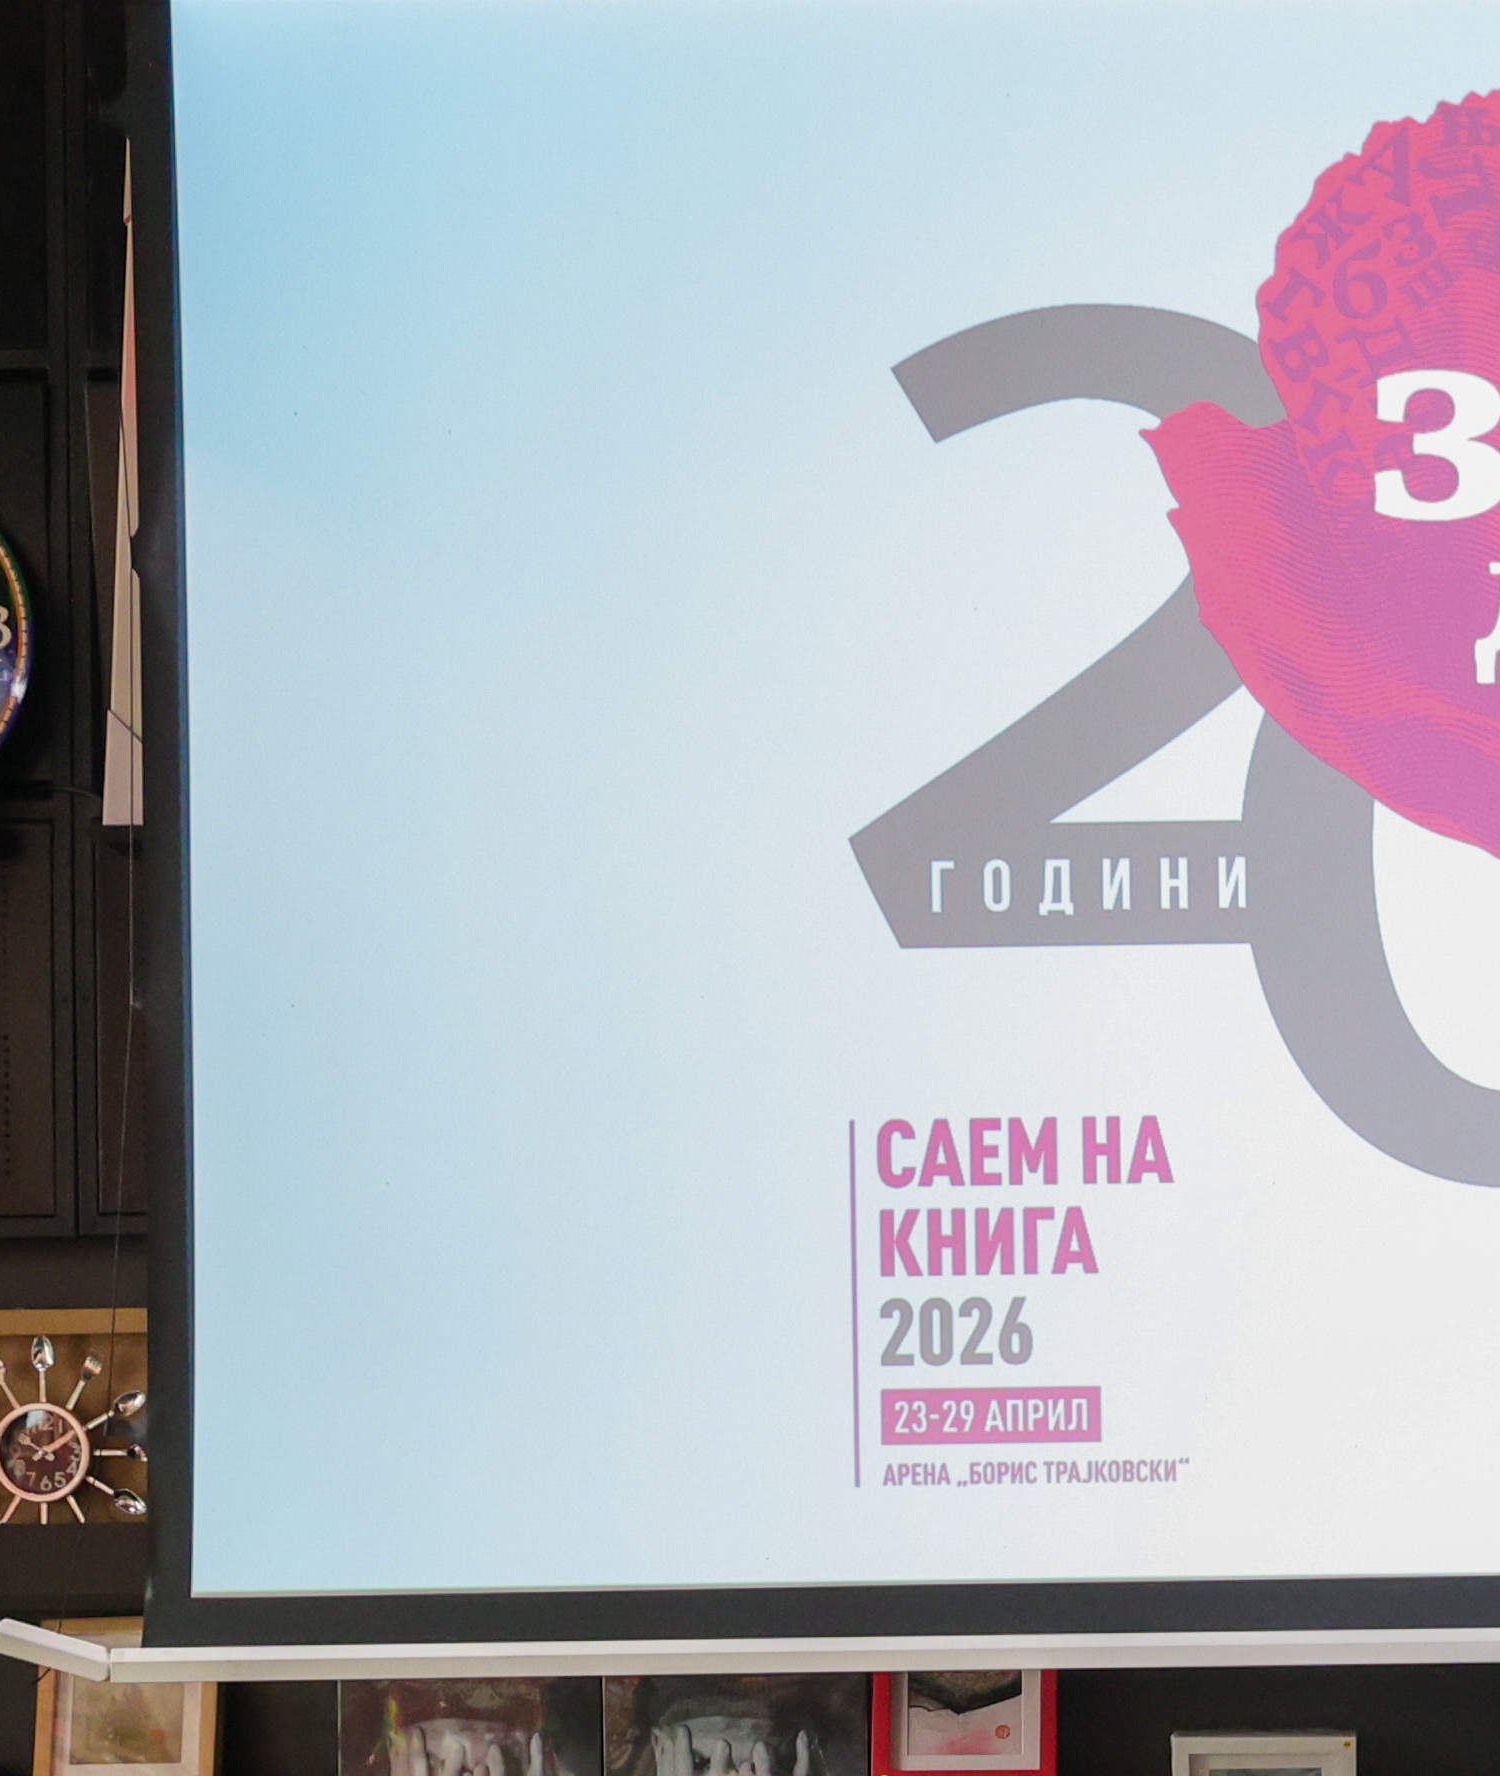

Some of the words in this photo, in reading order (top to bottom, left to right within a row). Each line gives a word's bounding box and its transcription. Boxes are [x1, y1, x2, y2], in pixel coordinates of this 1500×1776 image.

[928, 855, 1250, 918] ГОДИНИ
[876, 1118, 1059, 1189] САЕМ
[1082, 1115, 1175, 1185] НА
[879, 1206, 1099, 1277] КНИГА
[879, 1296, 1034, 1367] 2026
[894, 1400, 976, 1434] 23-29
[984, 1397, 1089, 1433] АПРИЛ
[39, 1477, 53, 1492] 6
[53, 1471, 67, 1489] 5
[882, 1463, 952, 1487] АРЕНА
